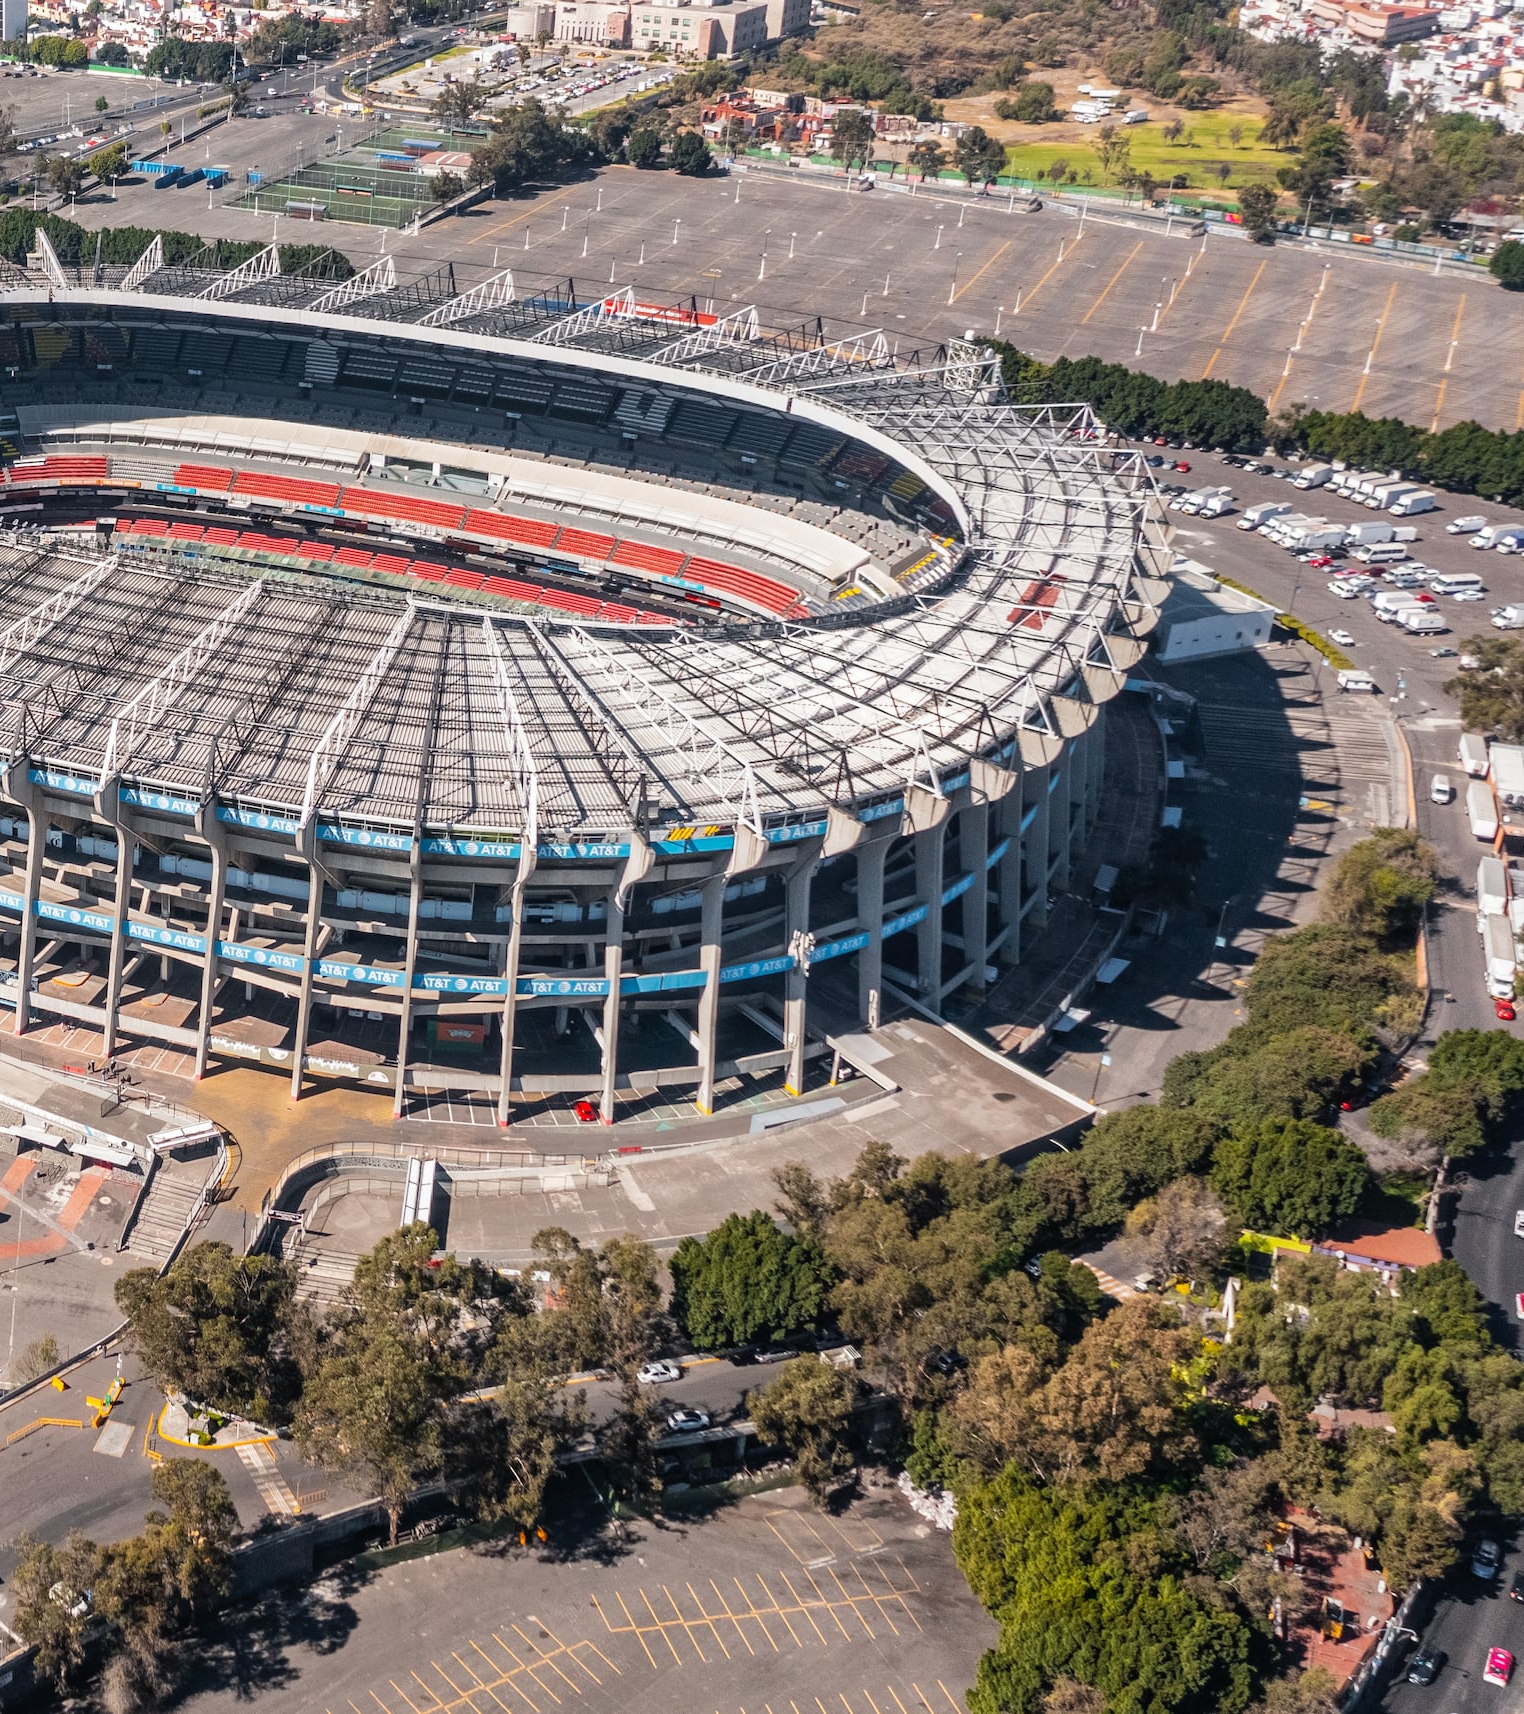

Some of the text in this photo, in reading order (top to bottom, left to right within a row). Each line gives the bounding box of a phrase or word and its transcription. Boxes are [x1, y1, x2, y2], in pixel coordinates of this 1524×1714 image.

[35, 770, 62, 788] AT&T
[126, 789, 154, 806] AT&T
[223, 808, 253, 824] AT&T
[876, 802, 900, 817] AT&T
[322, 826, 406, 849] AT&T AT&T
[792, 823, 821, 839] AT&T
[428, 840, 514, 857] AT&T AT&T
[538, 845, 621, 857] AT&T AT&T
[39, 904, 111, 930] AT&T AT&T
[129, 924, 203, 949] AT&T AT&T
[841, 936, 865, 952] AT&T
[221, 946, 299, 969] AT&T AT&T
[320, 963, 400, 985] AT&T AT&T
[719, 957, 790, 981] AT&T AT&T
[420, 977, 503, 993] AT&T AT&T
[523, 981, 605, 994] AT&T AT&T
